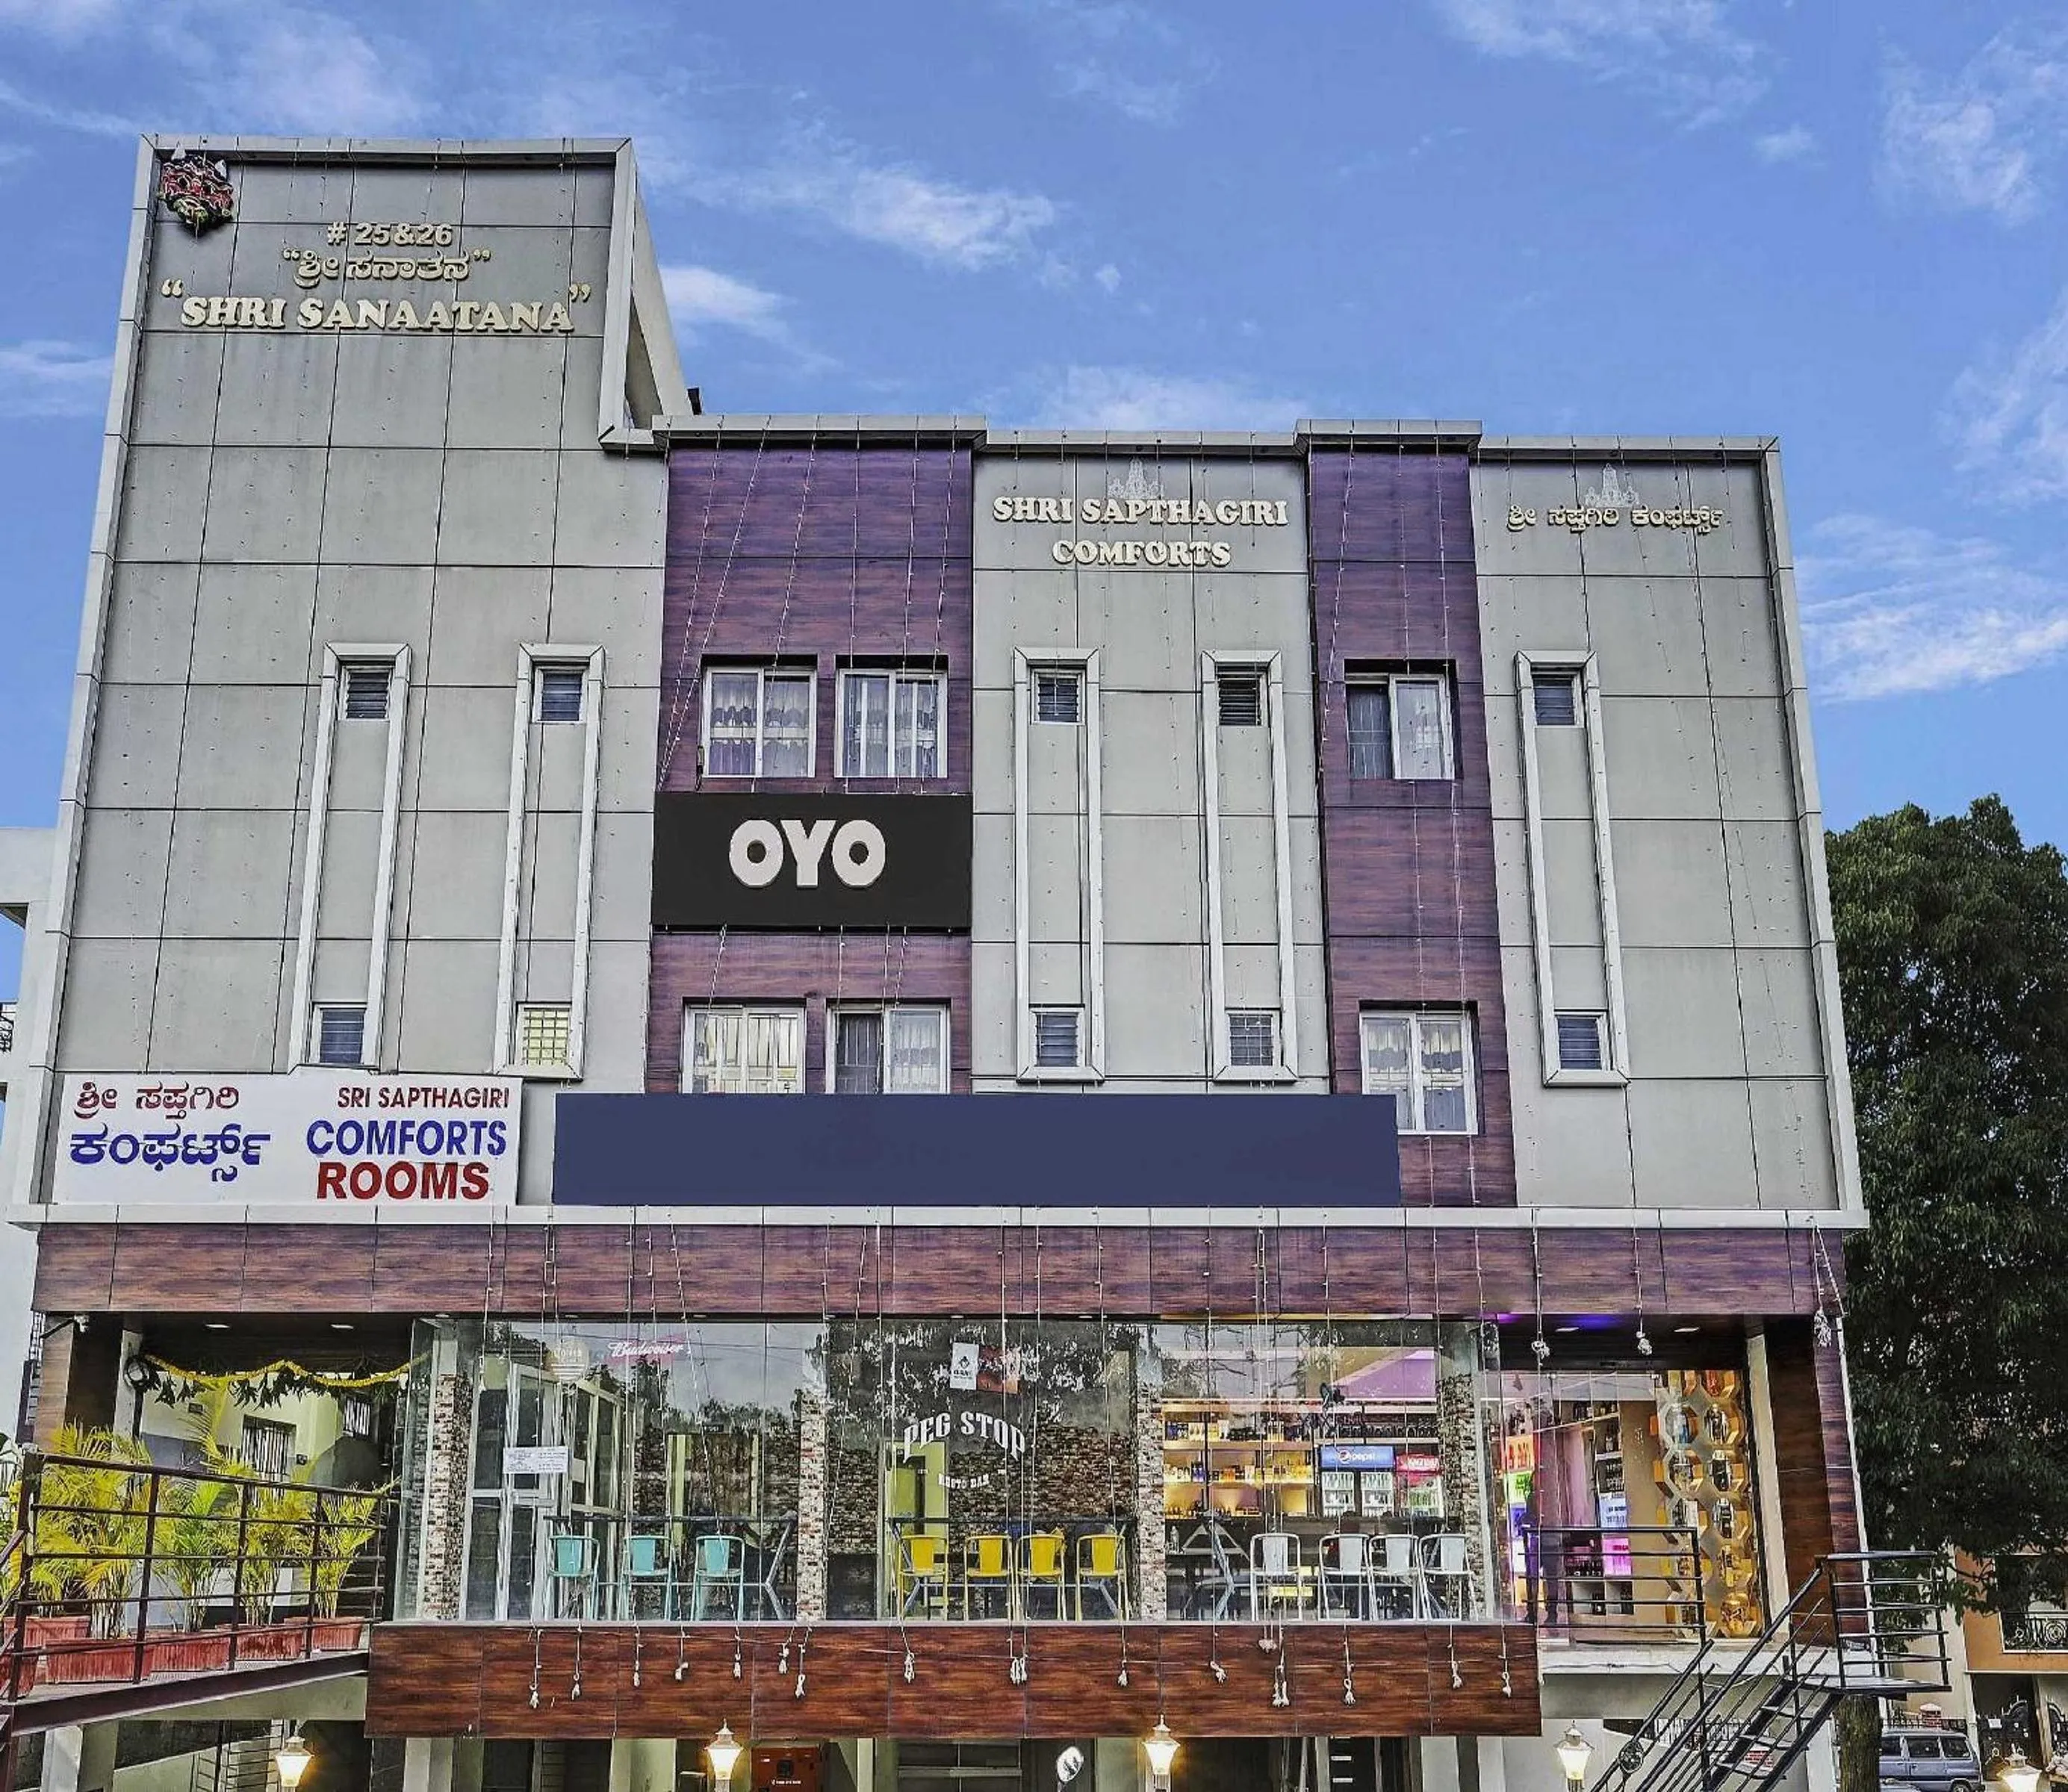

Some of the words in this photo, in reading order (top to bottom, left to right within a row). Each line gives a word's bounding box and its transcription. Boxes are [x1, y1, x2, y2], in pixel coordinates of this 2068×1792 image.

[354, 223, 453, 248] 25&26
[993, 497, 1073, 523] SHRI
[1081, 498, 1290, 526] SAPTHAGIRI
[1052, 539, 1232, 567] COMFORTS
[728, 819, 886, 889] OYO
[74, 1081, 118, 1120] ಶ್ರೀ
[136, 1081, 240, 1120] ಸಪ್ತಗಿರಿ
[337, 1087, 371, 1110] SRI
[378, 1086, 509, 1110] SAPTHAGIRI
[307, 1119, 507, 1157] COMFORTS
[317, 1160, 490, 1200] ROOMS
[902, 1411, 951, 1464] PEG
[960, 1410, 1026, 1462] STOP
